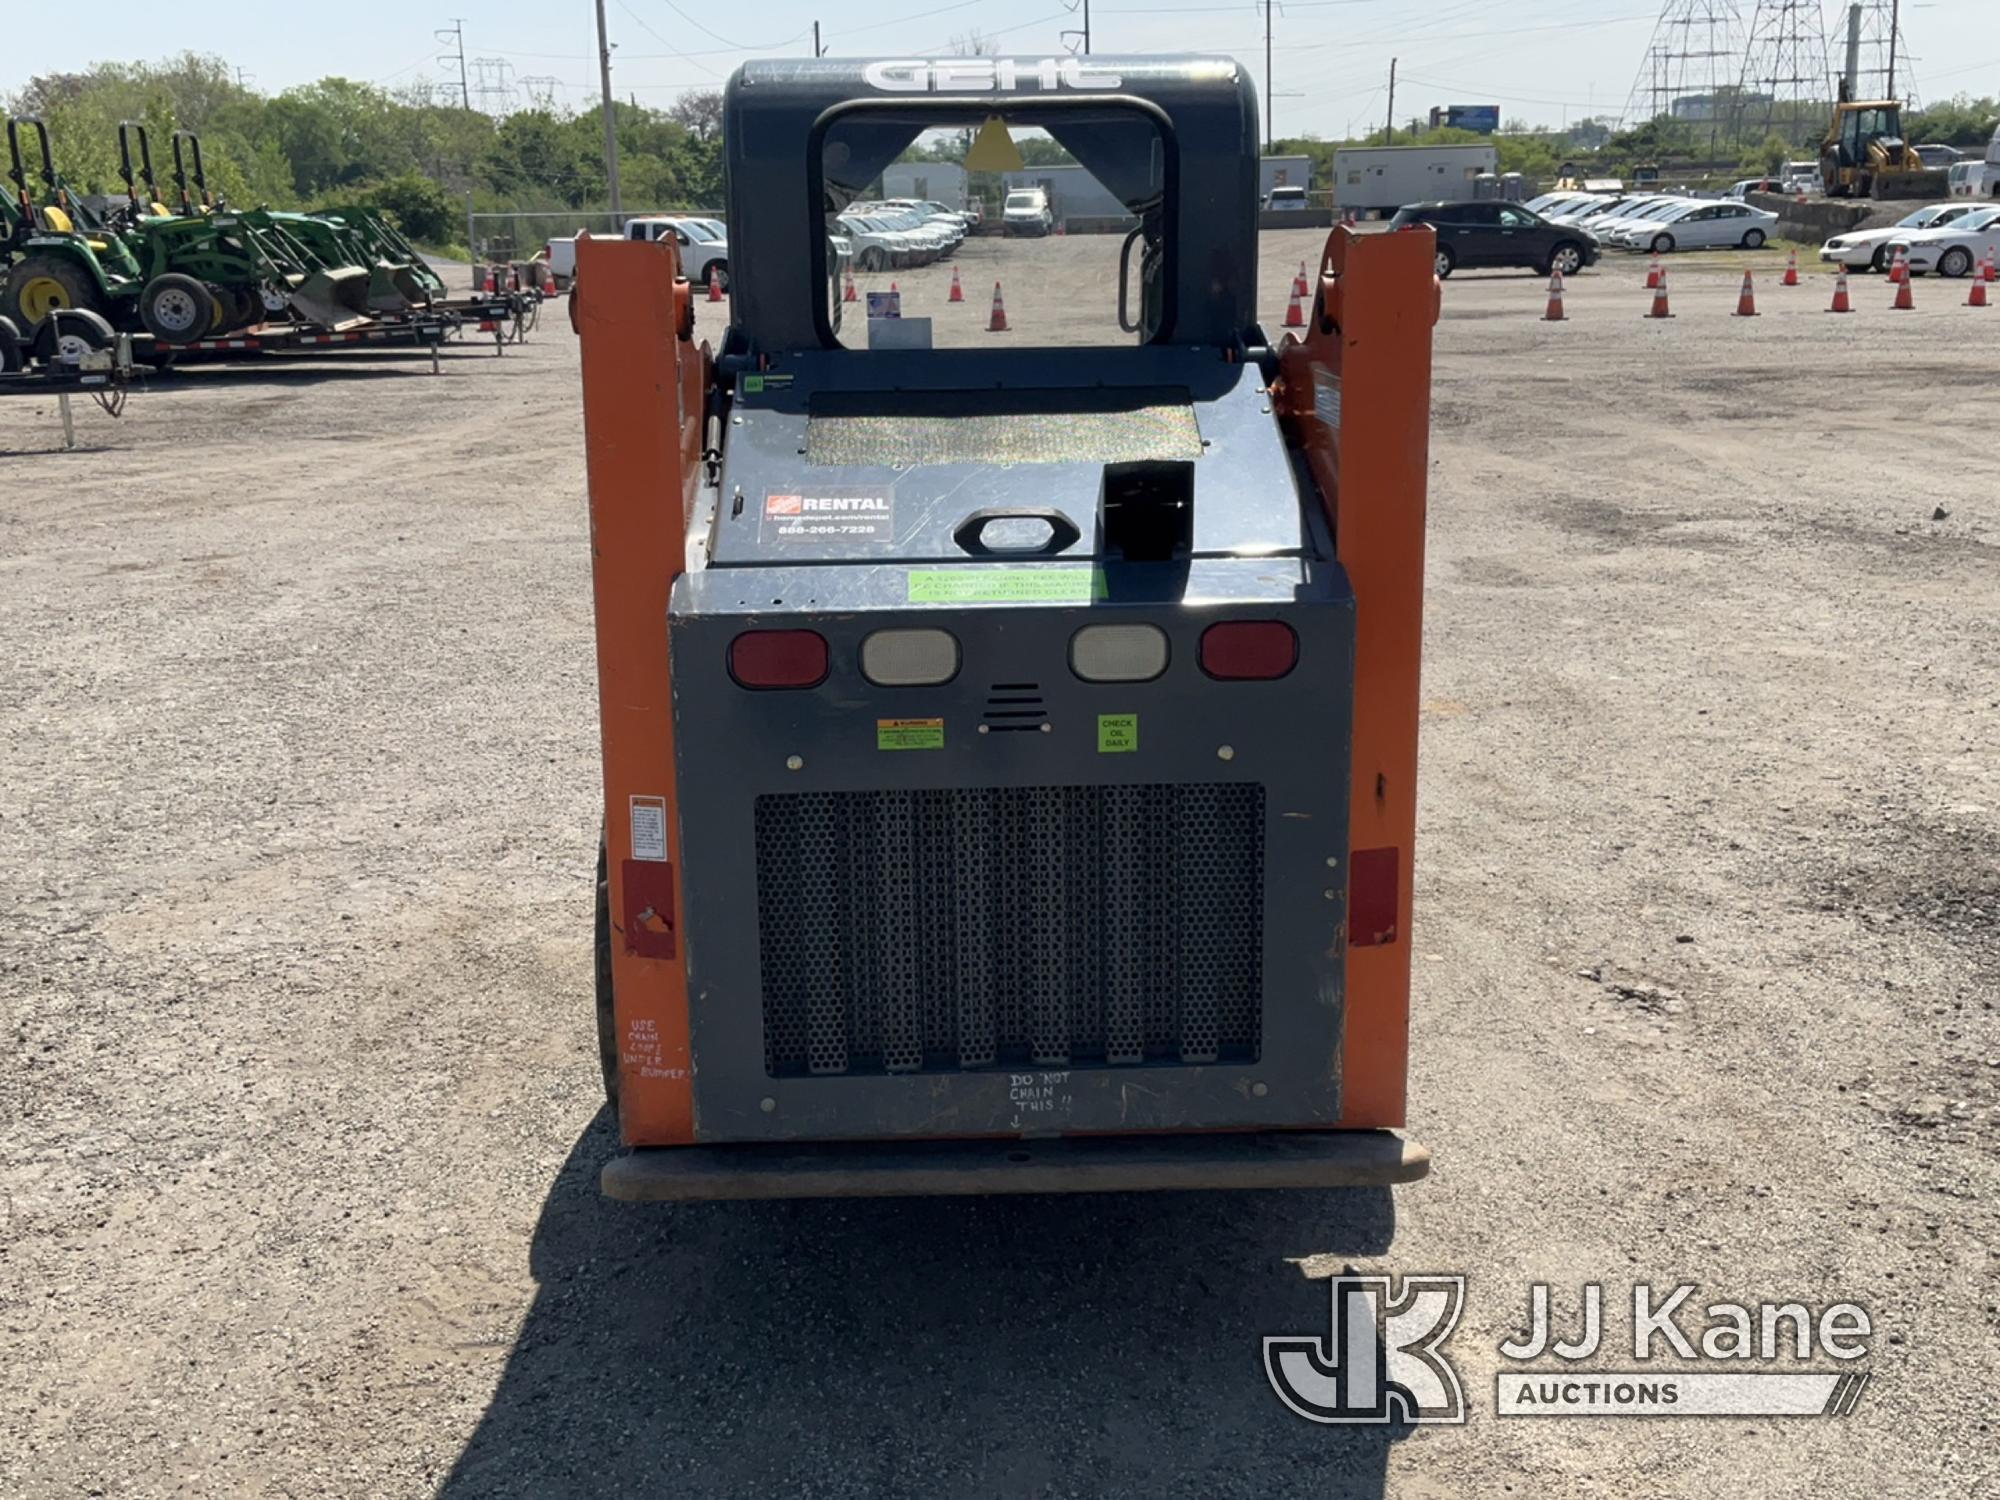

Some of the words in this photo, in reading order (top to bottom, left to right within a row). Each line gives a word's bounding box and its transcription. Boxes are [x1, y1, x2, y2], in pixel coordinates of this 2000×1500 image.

[864, 58, 1122, 92] GEHL
[802, 498, 889, 510] RENTAL
[773, 514, 890, 522] homedepot.com/rental
[778, 525, 875, 535] 888-266-7228
[1102, 719, 1133, 728] CHECK
[1110, 729, 1126, 737] OIL
[1105, 739, 1130, 747] DAILY
[631, 1019, 656, 1032] USE
[1009, 1074, 1034, 1087] DO
[1043, 1071, 1071, 1085] NOT
[1009, 1086, 1054, 1100] CHAIN
[1015, 1100, 1054, 1112] THIS
